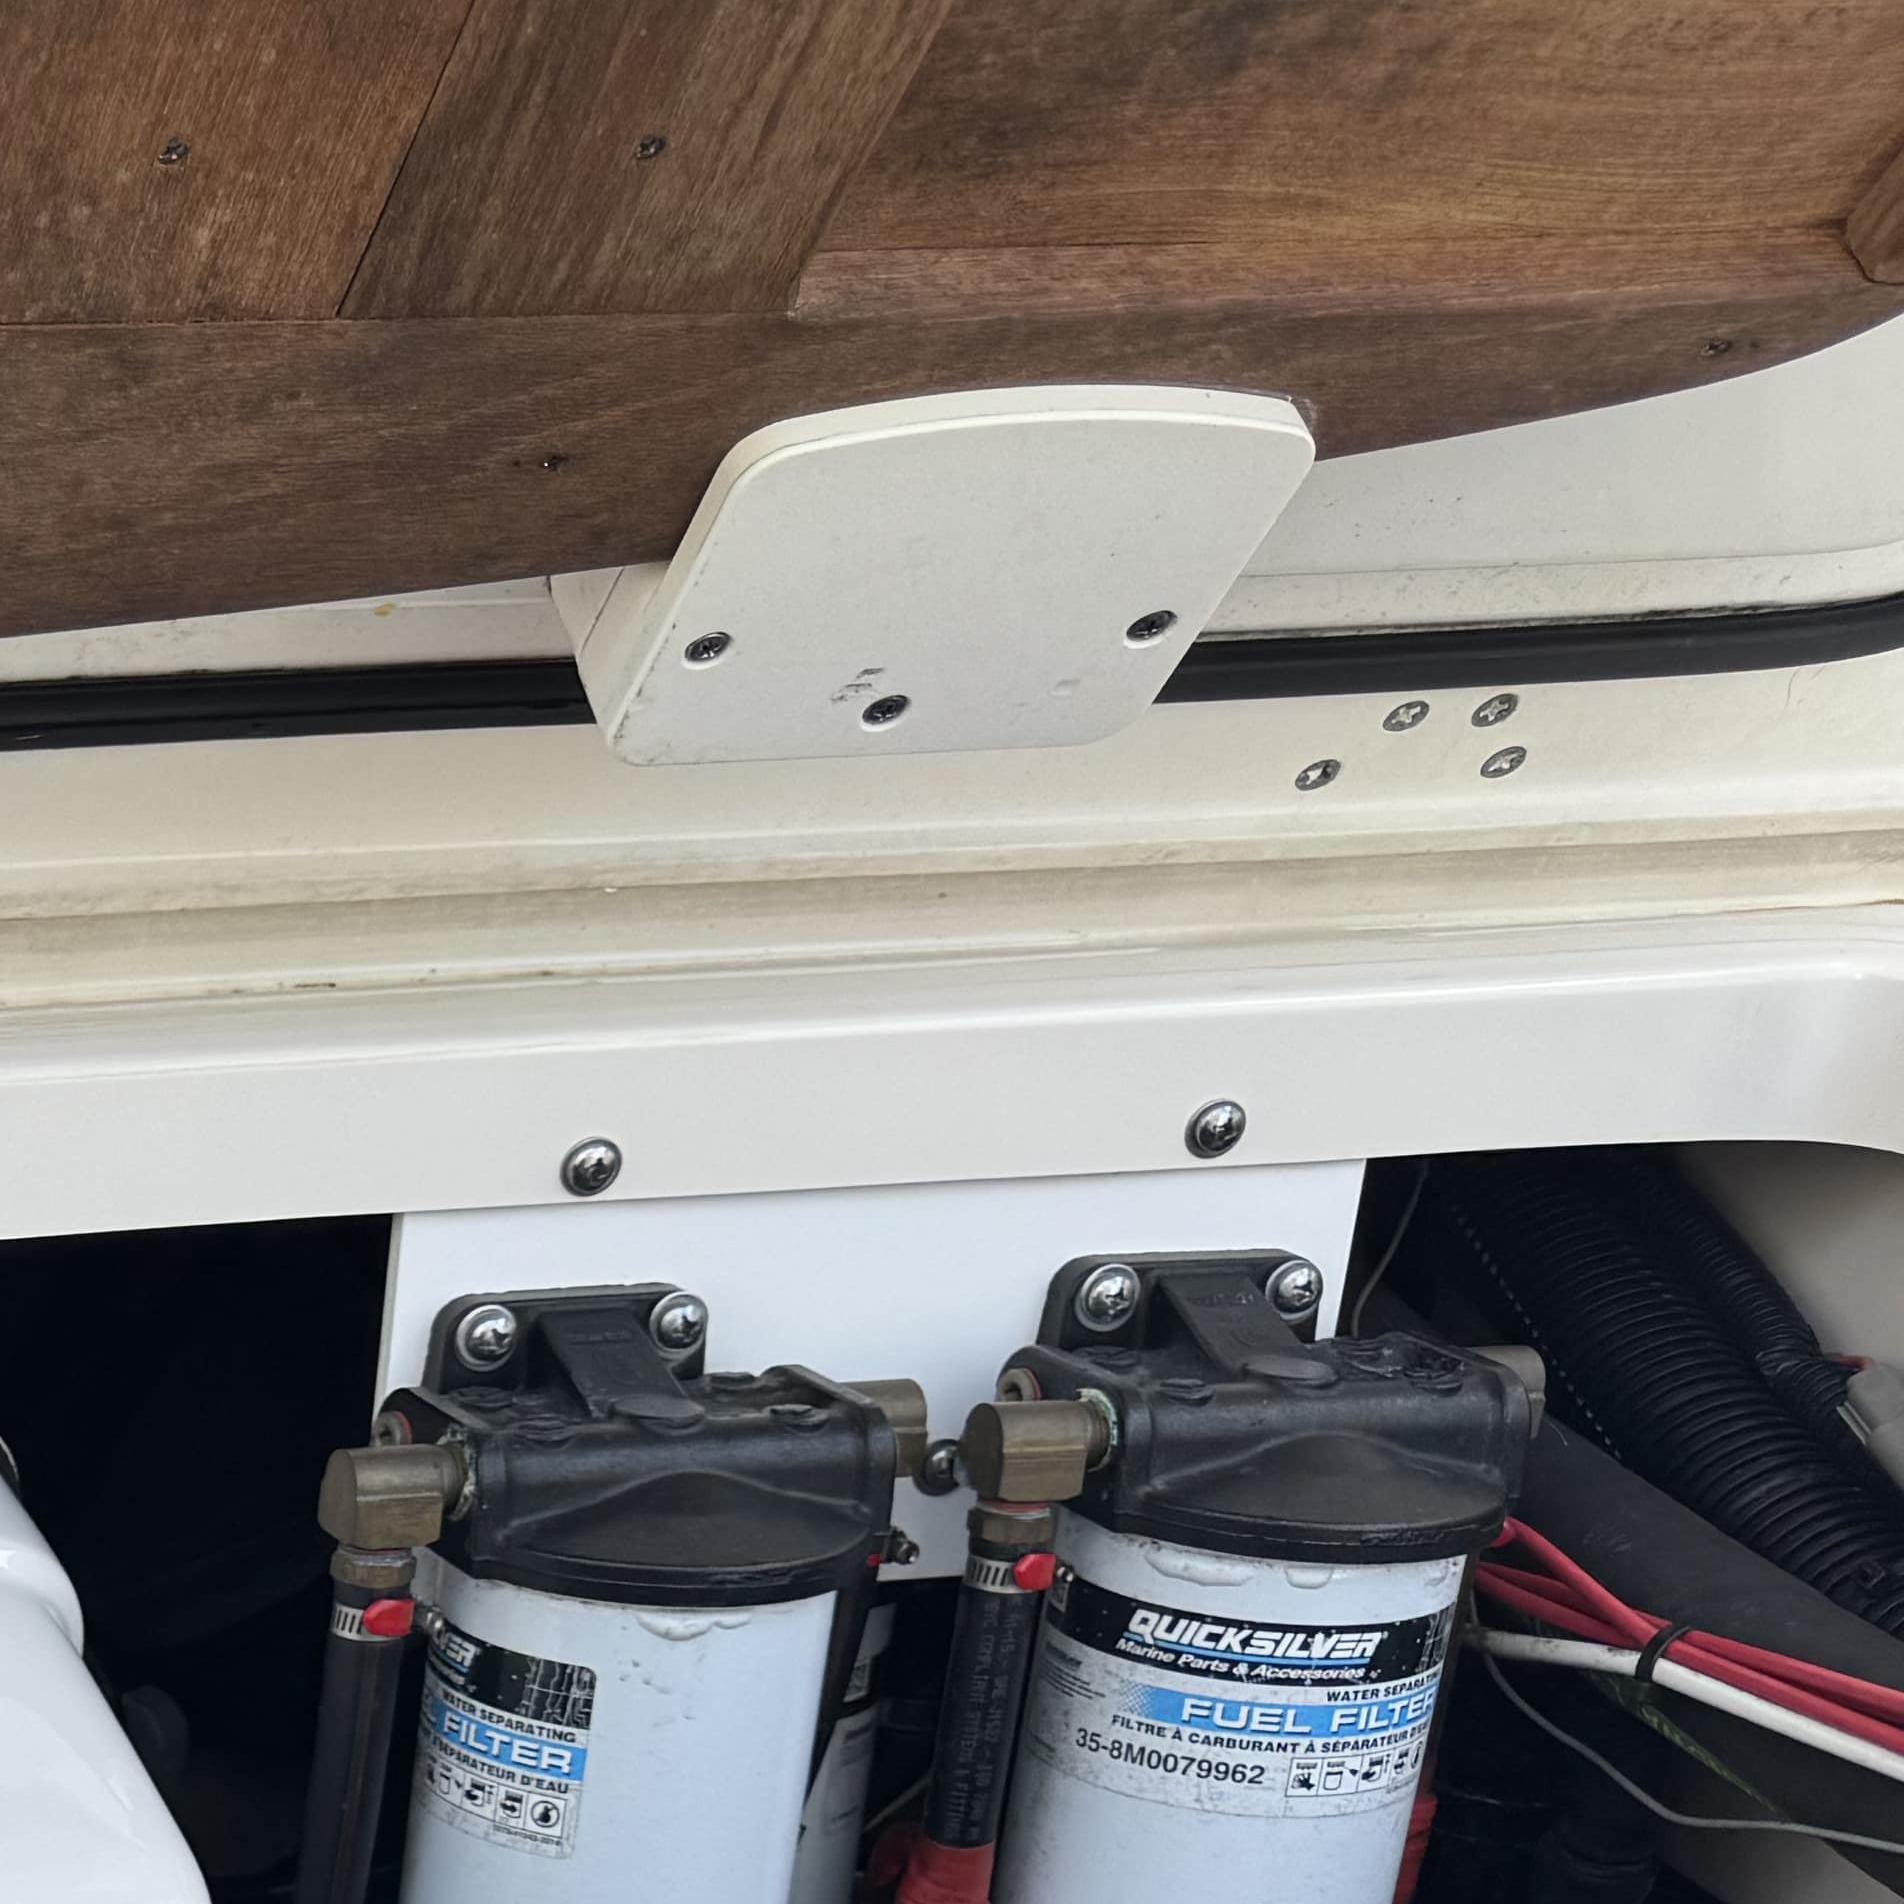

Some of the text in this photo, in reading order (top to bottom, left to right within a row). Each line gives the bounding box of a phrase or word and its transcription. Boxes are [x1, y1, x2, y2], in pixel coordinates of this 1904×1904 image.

[1127, 1608, 1384, 1659] QUICKSILVER
[1116, 1638, 1175, 1666] Marine
[1179, 1654, 1228, 1675] Parts
[1252, 1663, 1365, 1681] Accessories
[1181, 1687, 1436, 1734] FUEL FILTER
[1327, 1687, 1380, 1703] WATER
[443, 1711, 574, 1776] FILTER
[479, 1708, 576, 1743] SEPARATING
[1112, 1714, 1166, 1738] FILTRE
[1188, 1734, 1300, 1754] CARBURANT
[1075, 1727, 1265, 1786] 35-8M0079962
[521, 1773, 569, 1794] D'EAU
